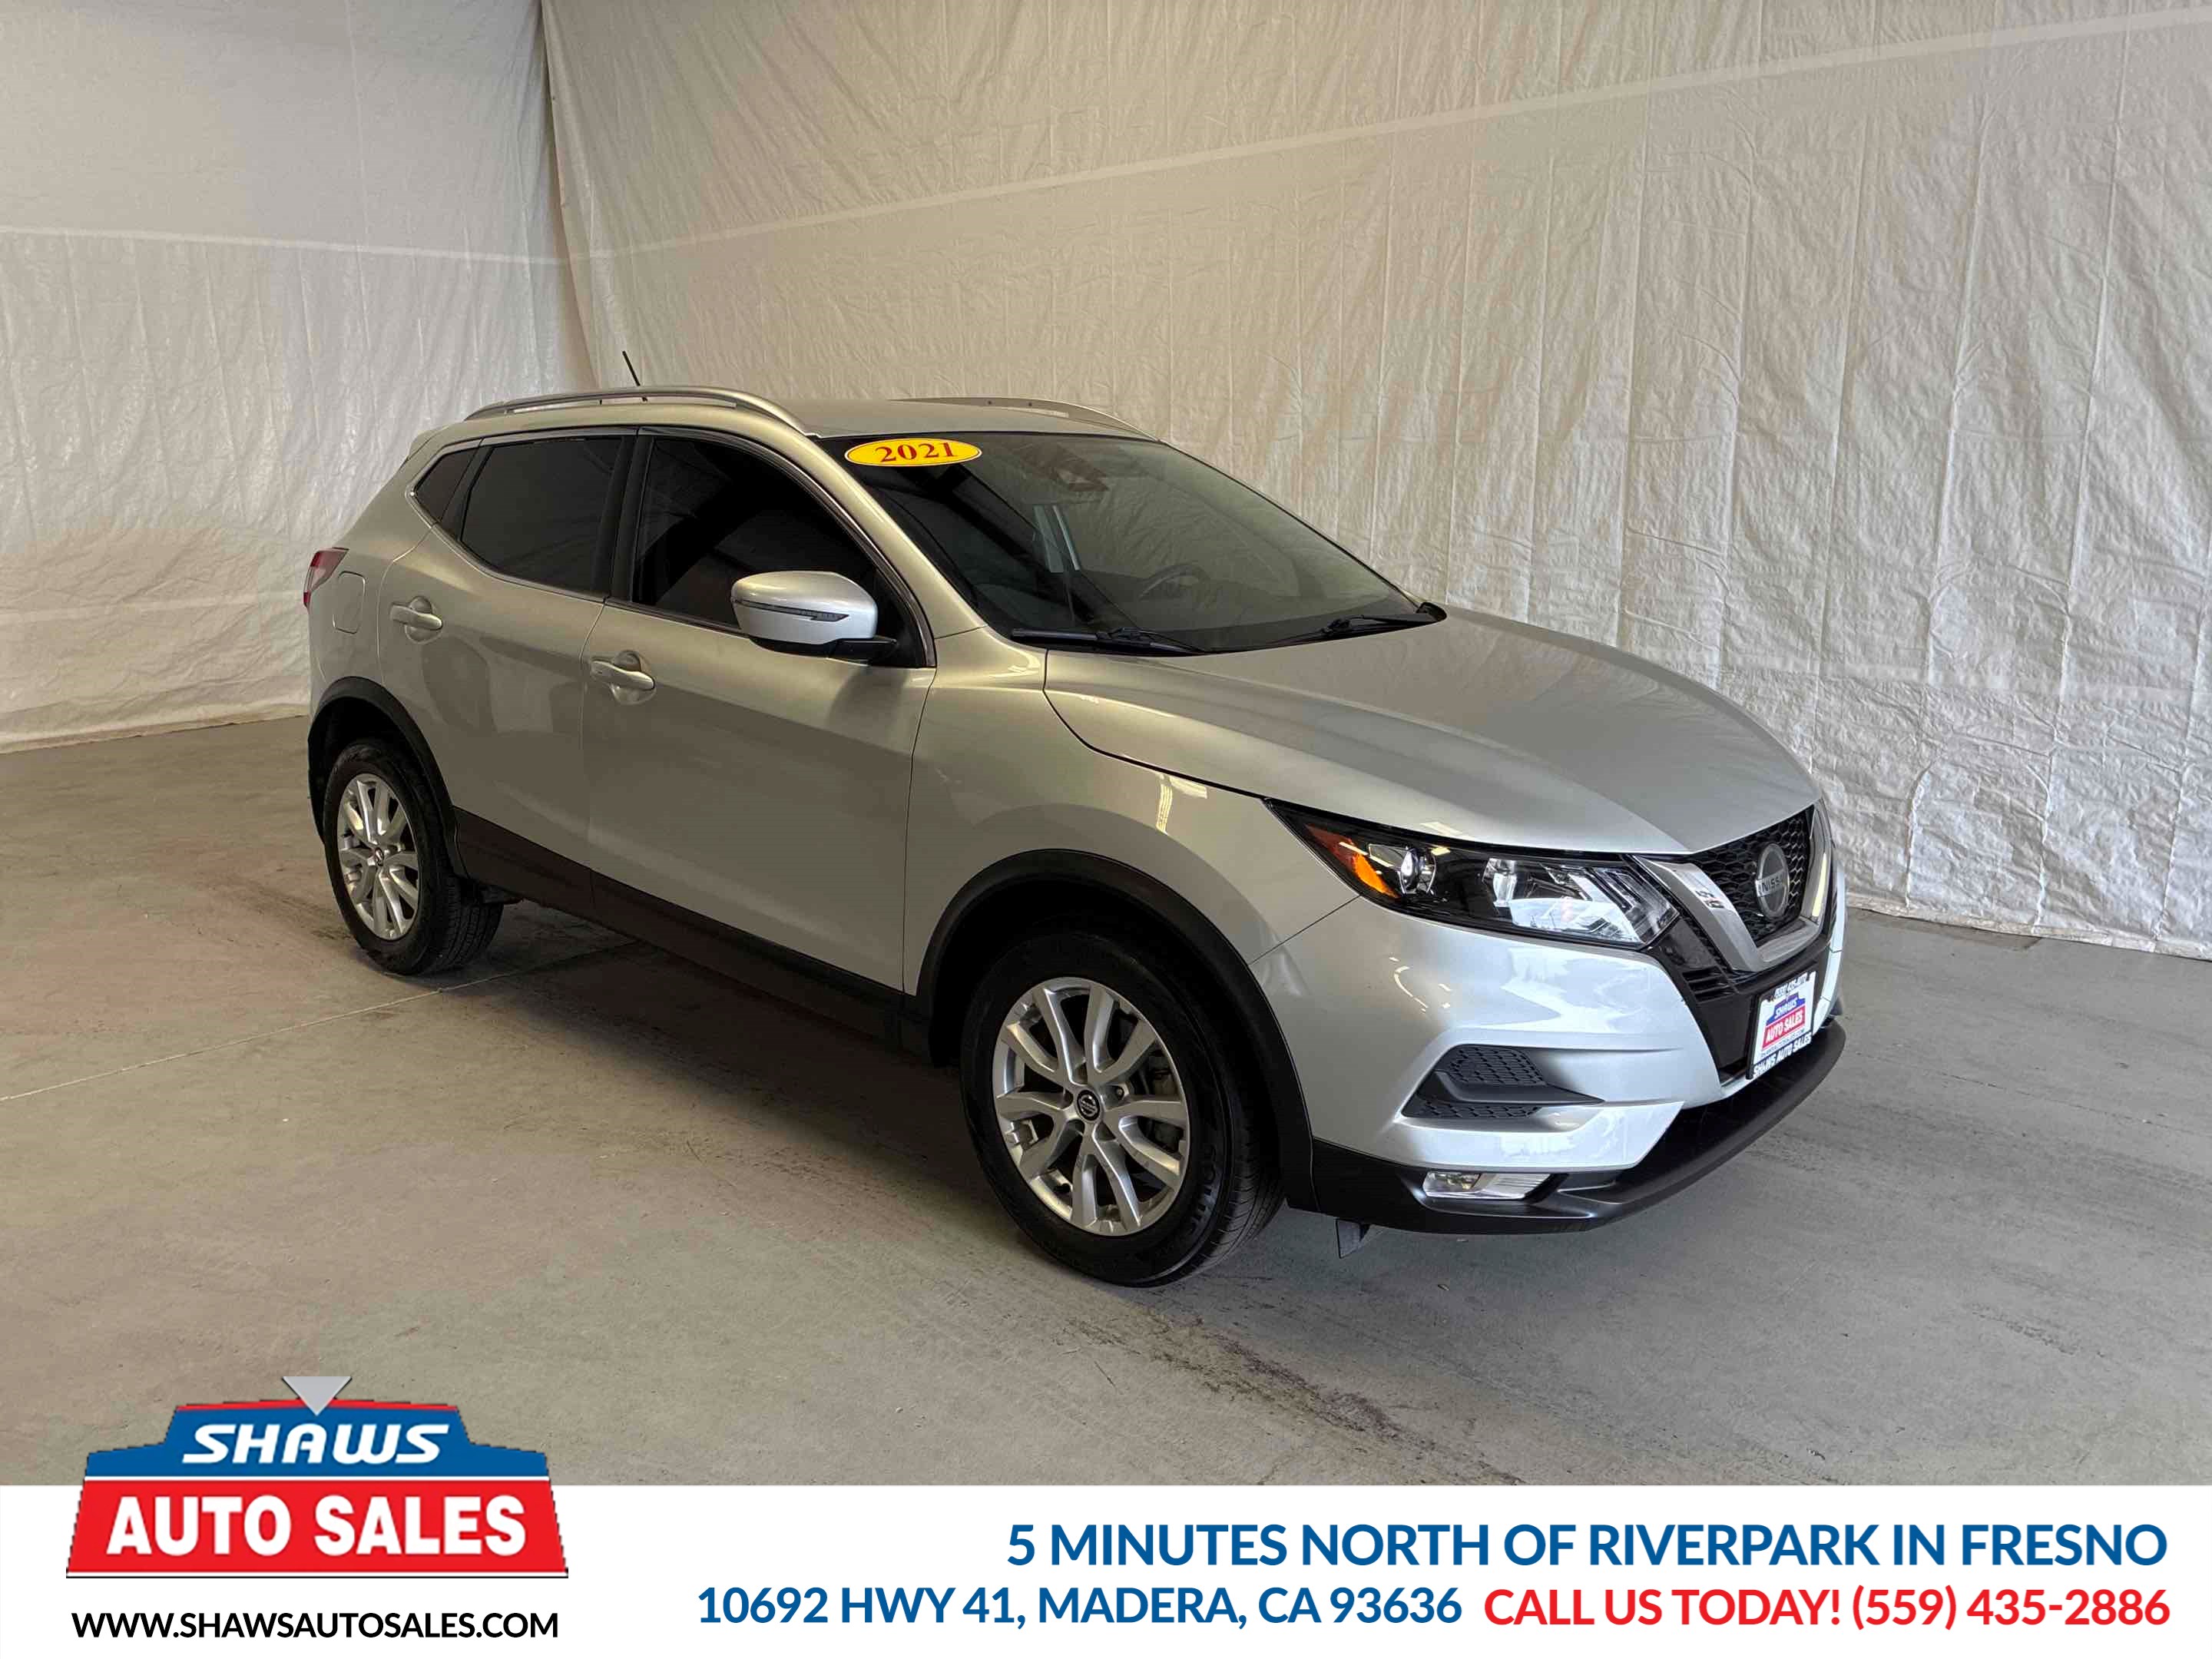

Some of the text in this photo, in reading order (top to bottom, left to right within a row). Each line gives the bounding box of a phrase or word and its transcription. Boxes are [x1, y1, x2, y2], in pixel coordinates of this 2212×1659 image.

[875, 442, 958, 462] 2021
[1766, 1022, 1784, 1044] AUTO
[1783, 1008, 1803, 1031] SALES
[1775, 1042, 1793, 1065] AUTO
[1792, 1031, 1812, 1053] SALES
